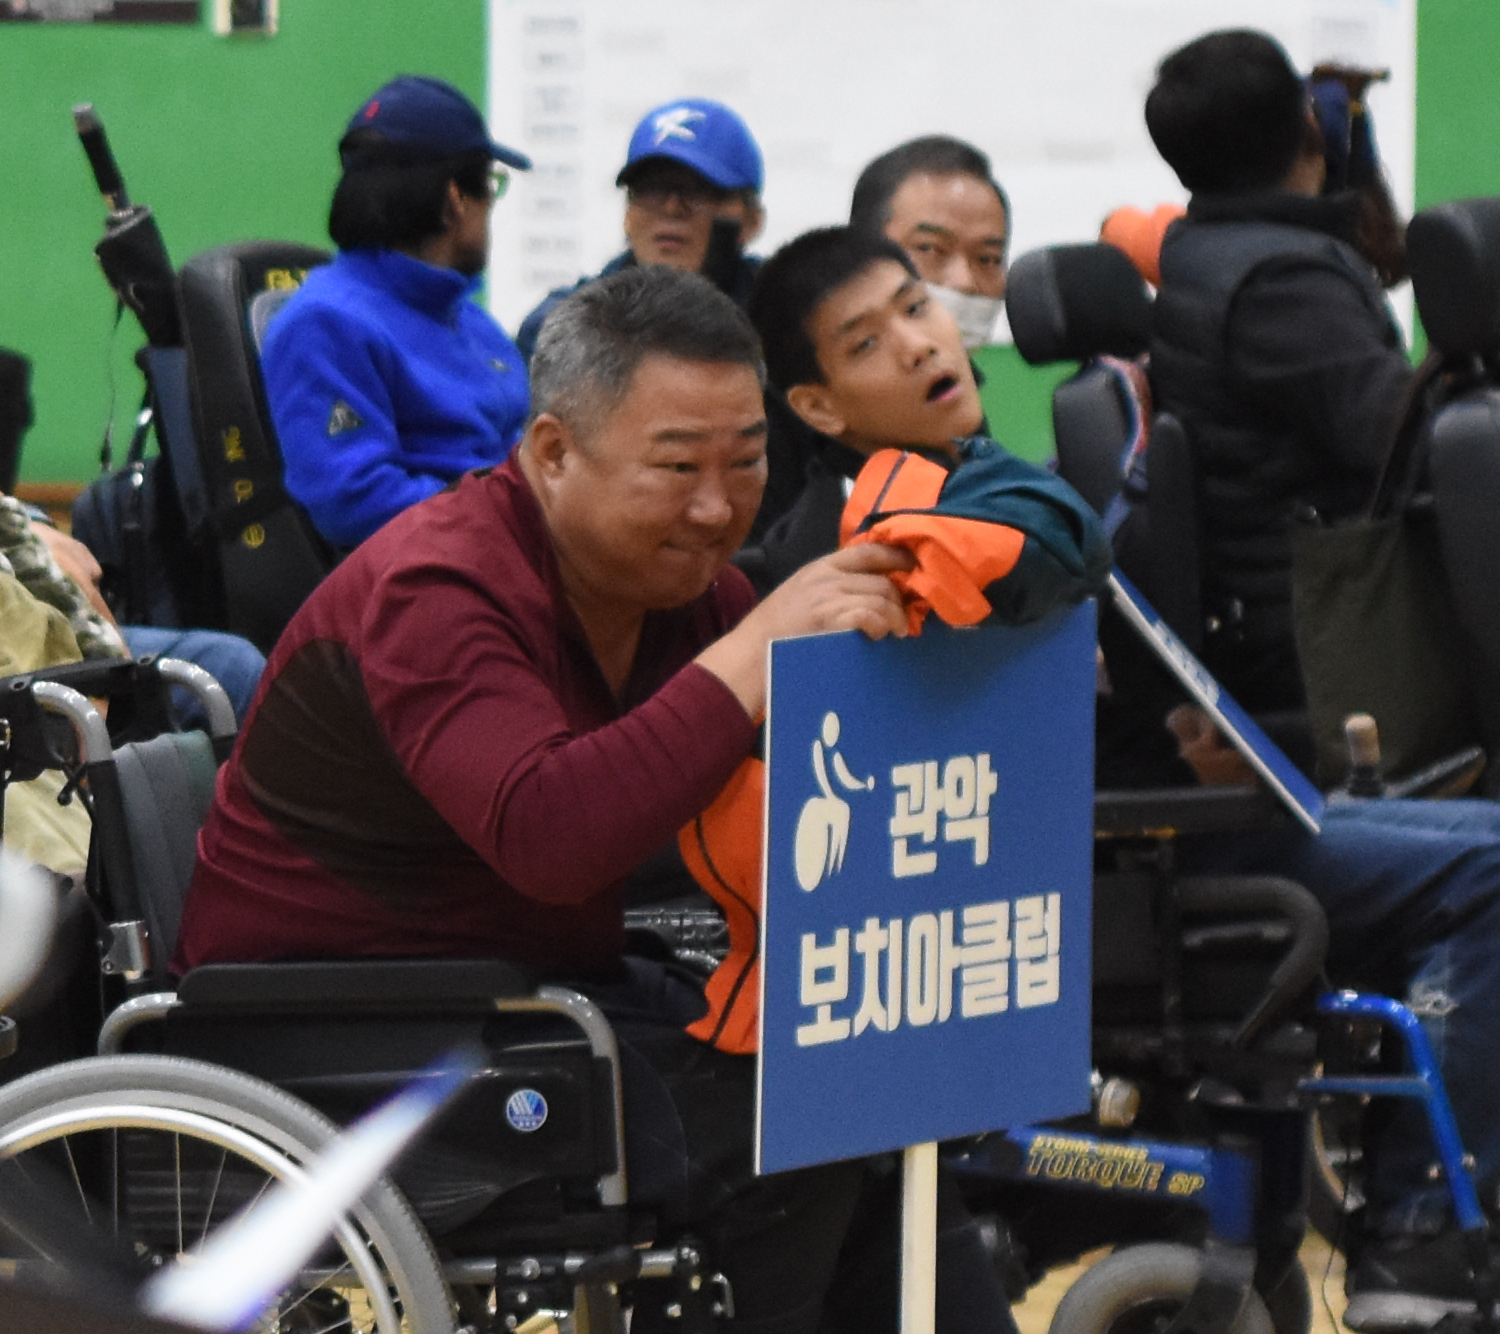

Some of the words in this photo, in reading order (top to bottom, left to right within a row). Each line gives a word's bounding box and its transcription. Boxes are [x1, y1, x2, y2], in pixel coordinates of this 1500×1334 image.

[889, 753, 998, 878] 관악
[795, 892, 1062, 1047] 보치아클럽
[1027, 1148, 1165, 1191] TORQUE
